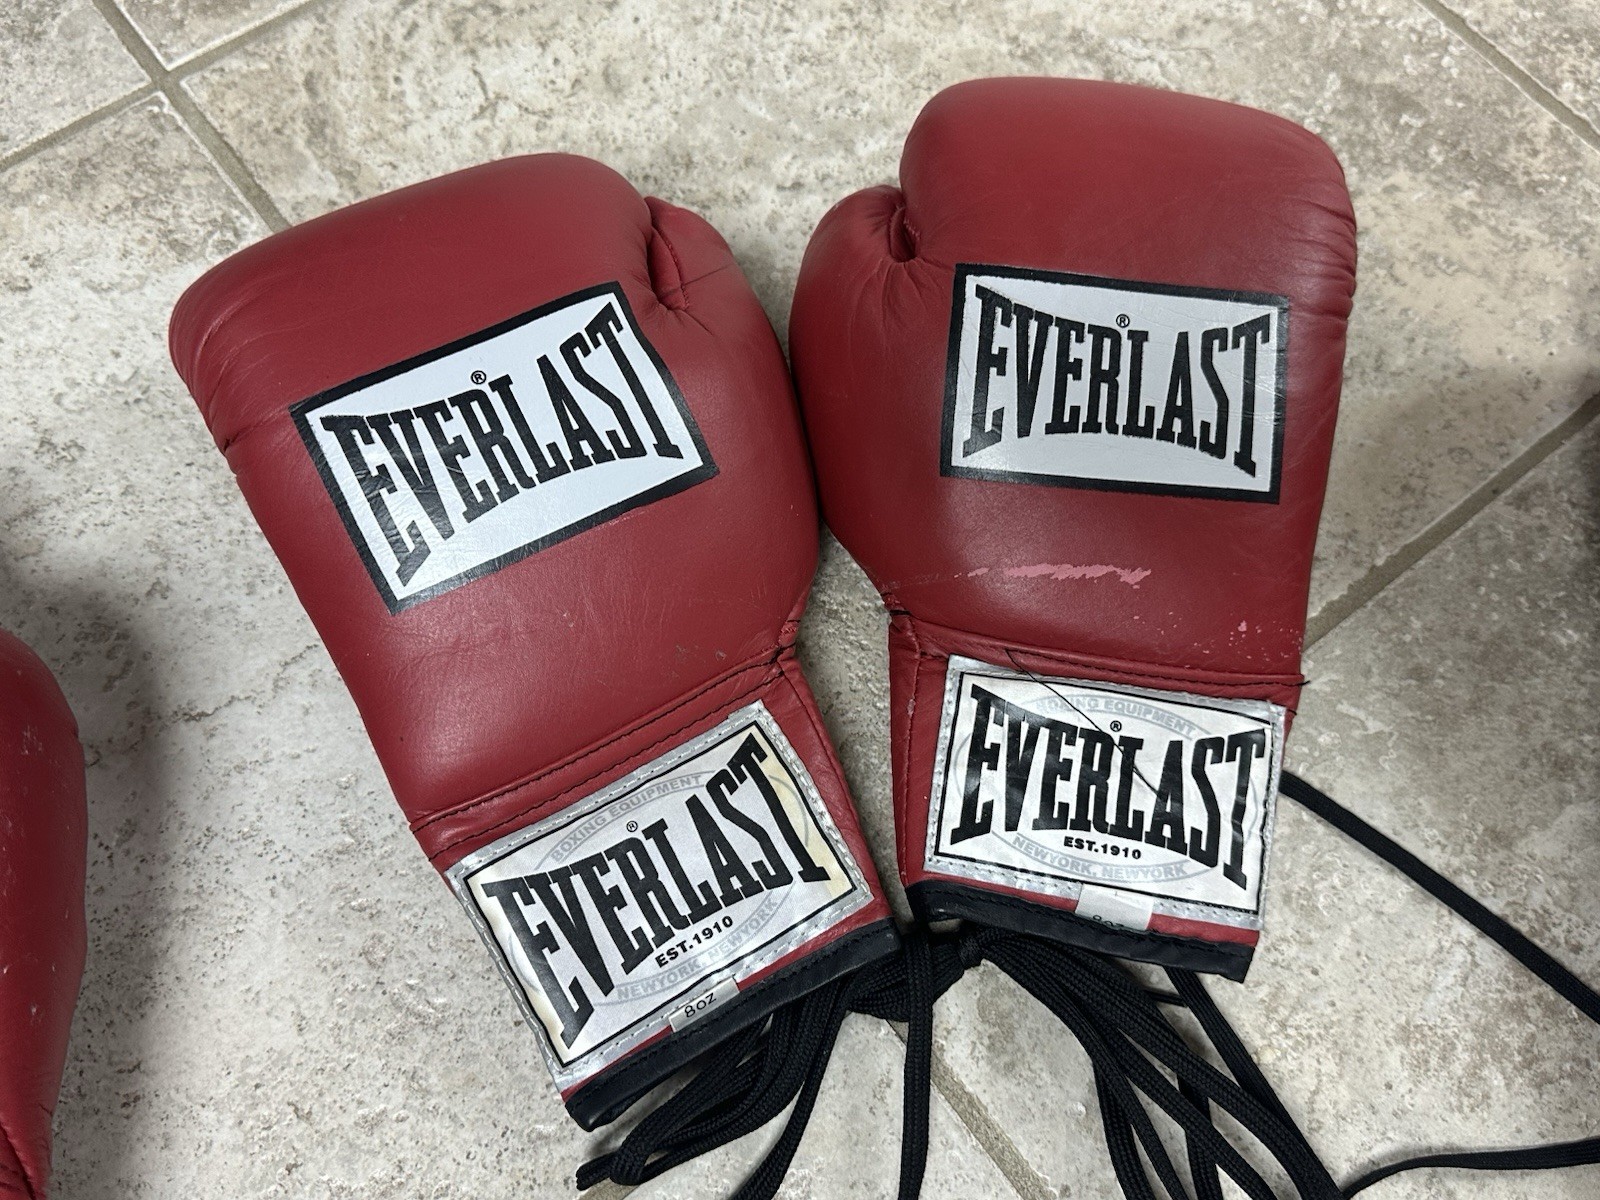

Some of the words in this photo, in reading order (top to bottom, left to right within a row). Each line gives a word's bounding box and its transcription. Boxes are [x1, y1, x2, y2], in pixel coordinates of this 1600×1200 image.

[320, 301, 684, 587] EVERLAST
[963, 284, 1270, 478] EVERLAST
[951, 684, 1265, 891] EVERLAST
[1036, 697, 1098, 713] OXING
[1103, 700, 1197, 736] EQUIPMENT
[481, 733, 831, 1049] EVERLAST
[550, 813, 607, 862] BOXING
[608, 774, 701, 817] EQUIPMENT
